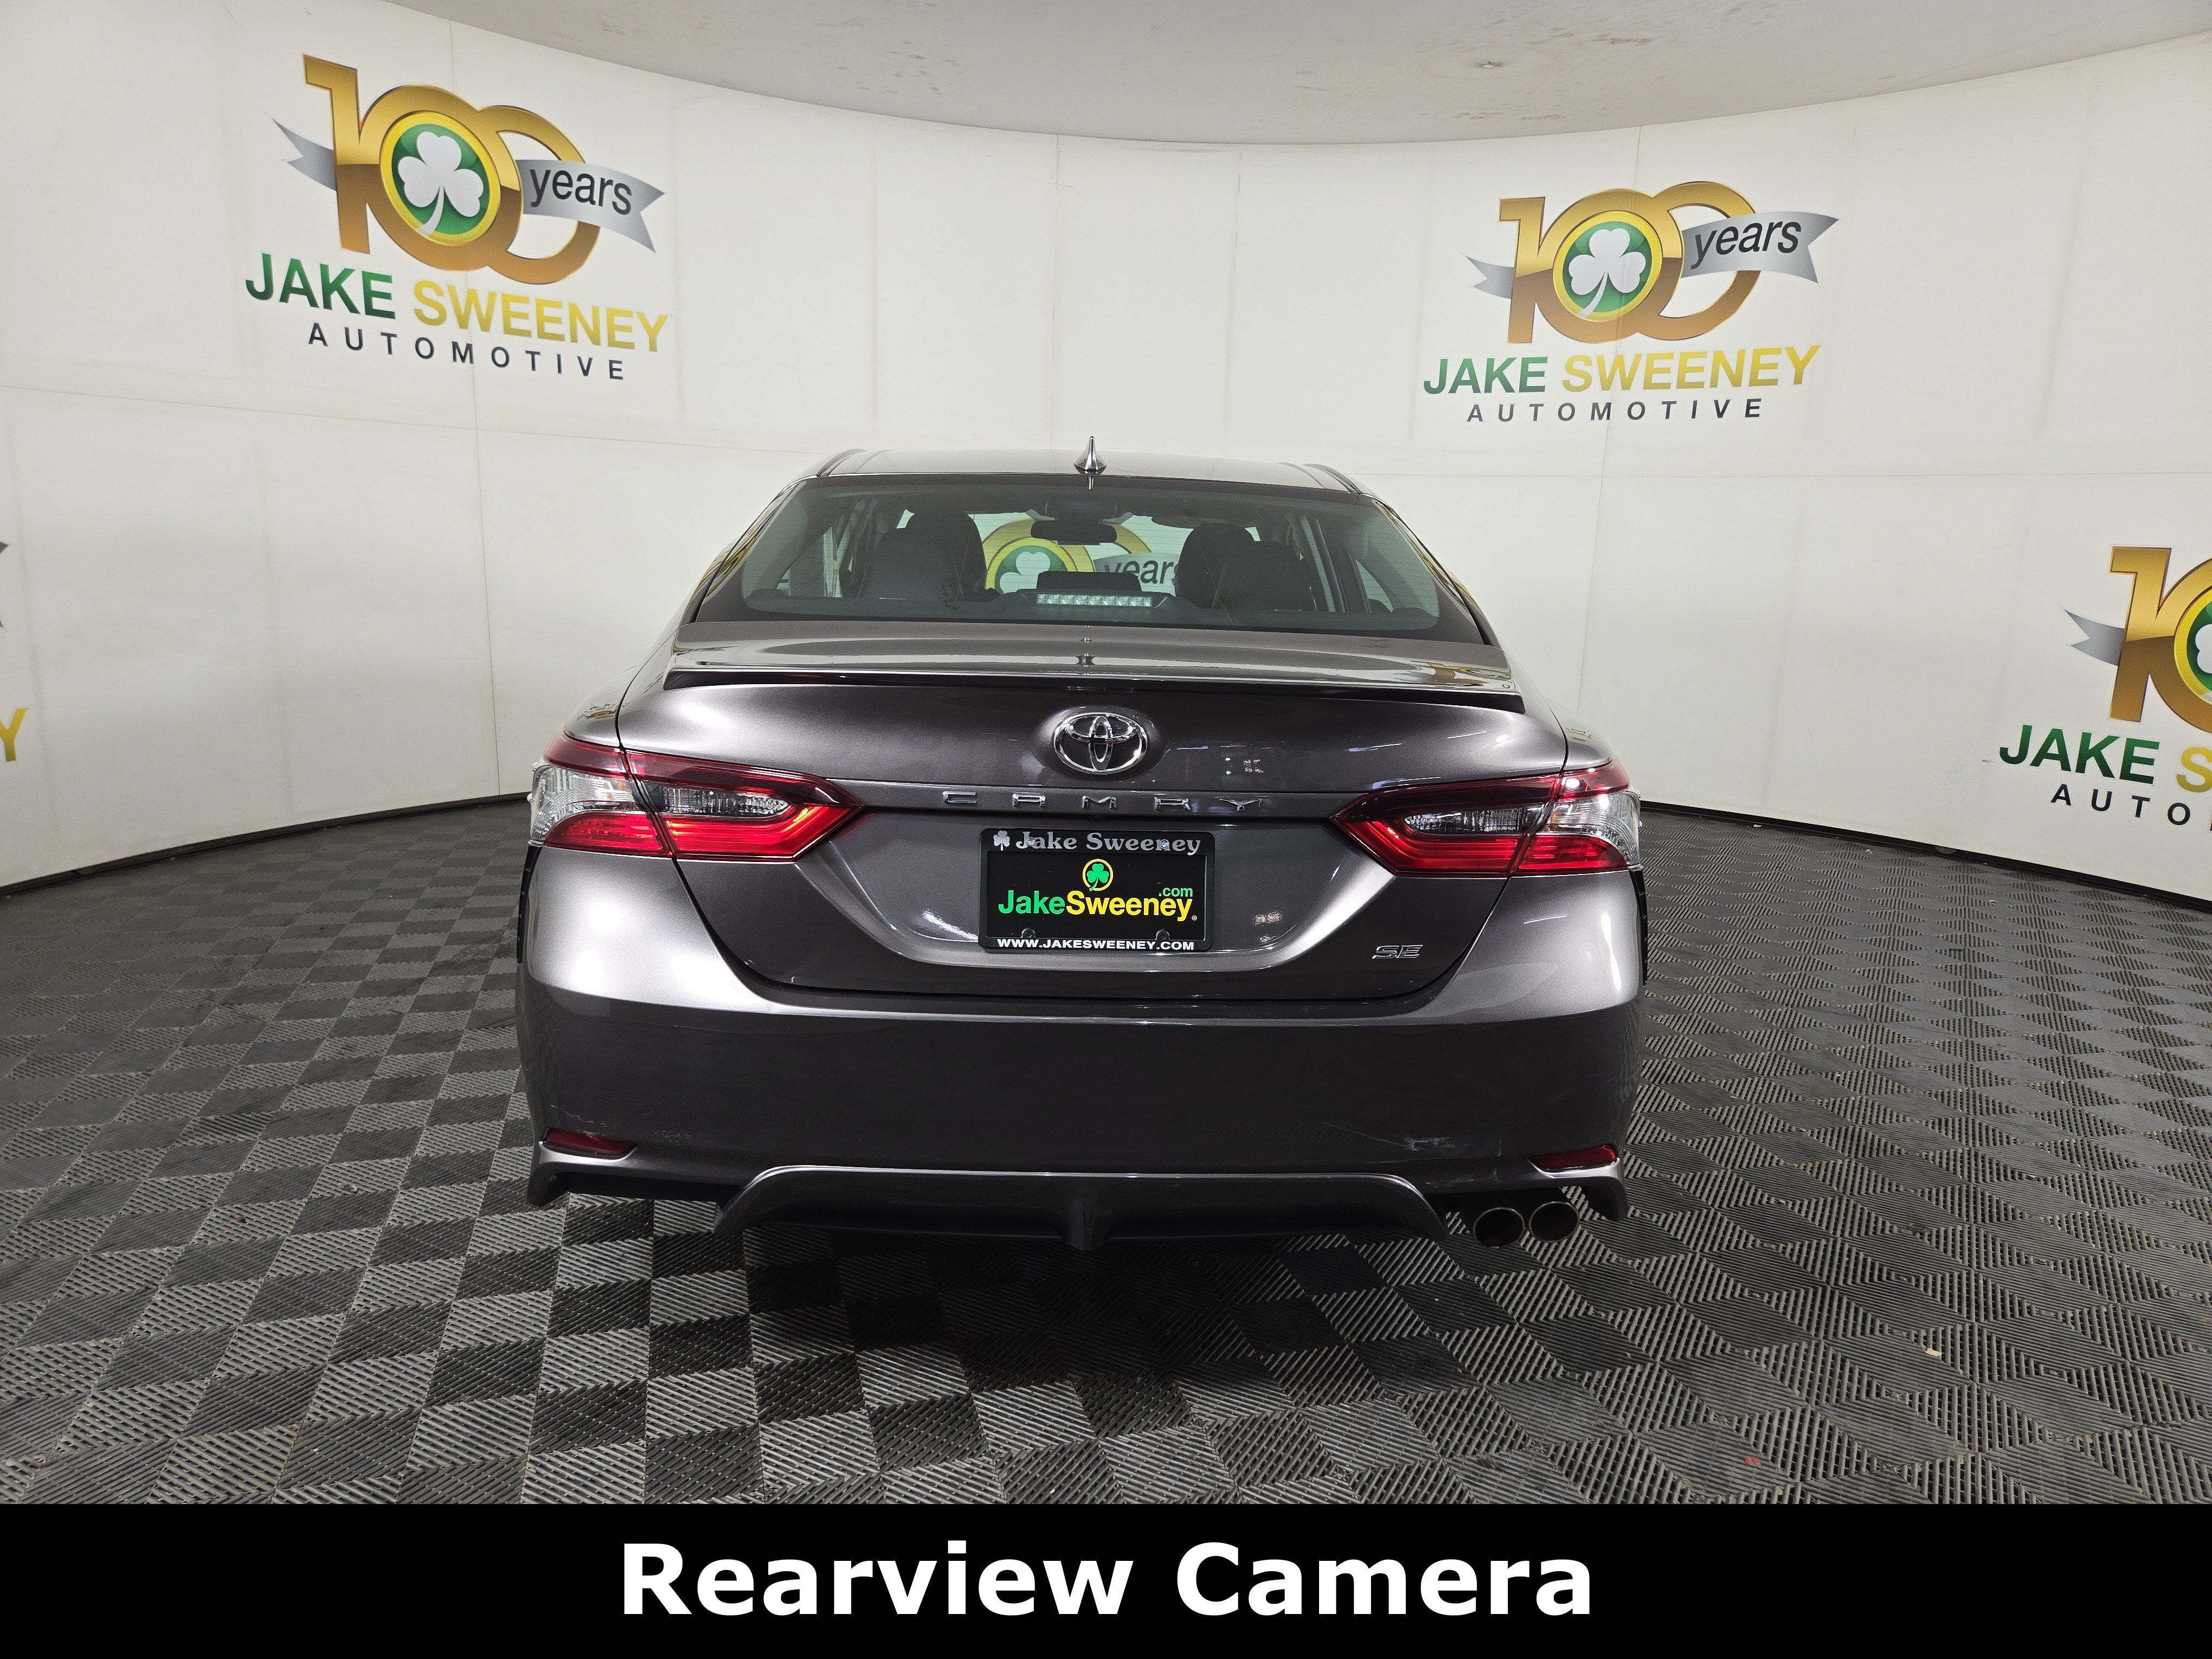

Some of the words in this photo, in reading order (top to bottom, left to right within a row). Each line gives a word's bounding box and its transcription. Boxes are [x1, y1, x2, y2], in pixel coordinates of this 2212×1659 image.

[529, 164, 633, 216] years
[1690, 218, 1802, 269] years
[246, 253, 396, 320] JAKE
[413, 280, 668, 353] SWEENEY
[308, 323, 624, 381] AUTOMOTIVE
[1423, 356, 1548, 395] JAKE
[1561, 345, 1822, 393] SWEENEY
[1466, 397, 1763, 423] AUTOMOTIVE
[1999, 724, 2160, 785] JAKE
[942, 790, 1263, 812] CAMRY
[1015, 831, 1077, 850] Jake
[1086, 832, 1201, 856] Sweeney
[997, 938, 1194, 950] WWW.JAKESWEENEY.COM
[1372, 944, 1424, 959] SE
